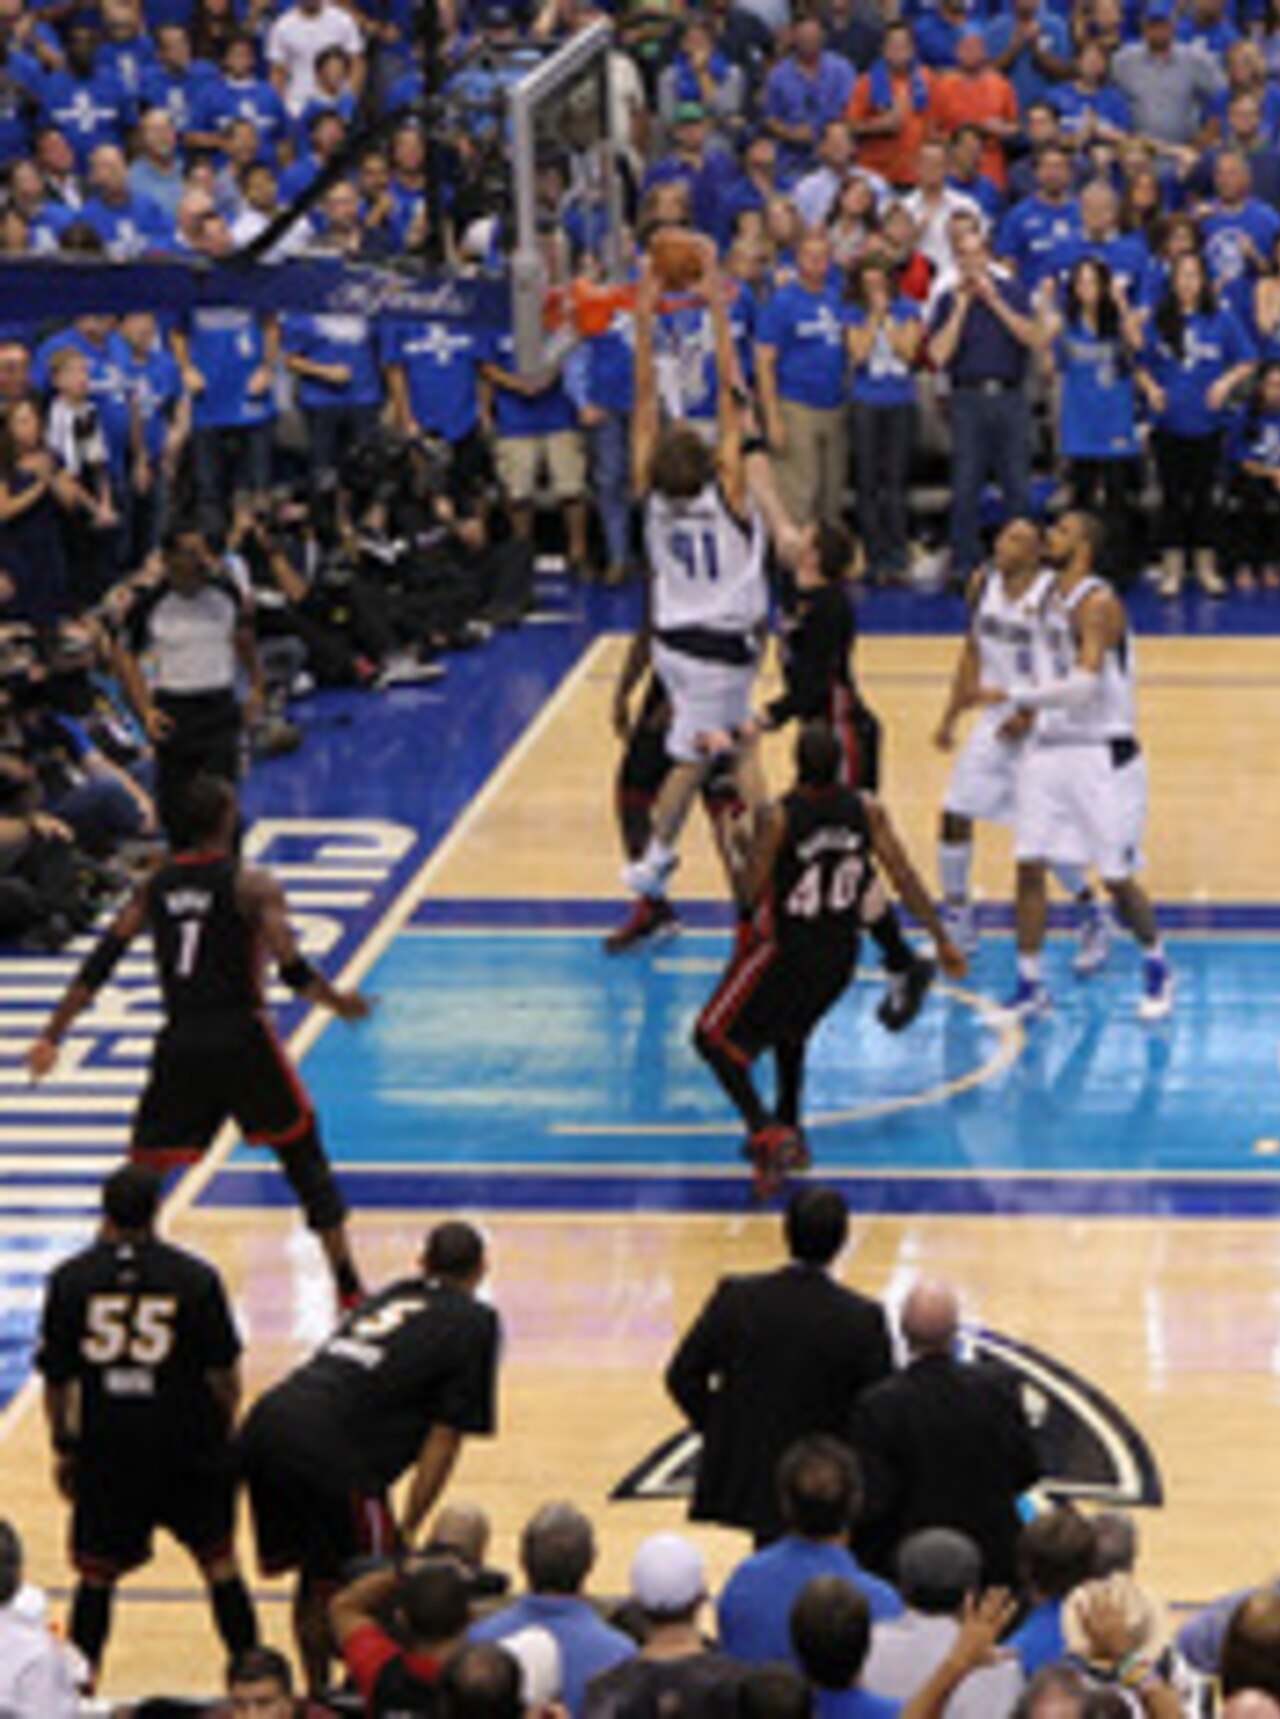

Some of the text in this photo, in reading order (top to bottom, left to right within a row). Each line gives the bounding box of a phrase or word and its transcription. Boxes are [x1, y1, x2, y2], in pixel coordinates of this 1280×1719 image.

[787, 856, 864, 918] 40
[177, 919, 201, 977] 1
[79, 1294, 178, 1364] 55
